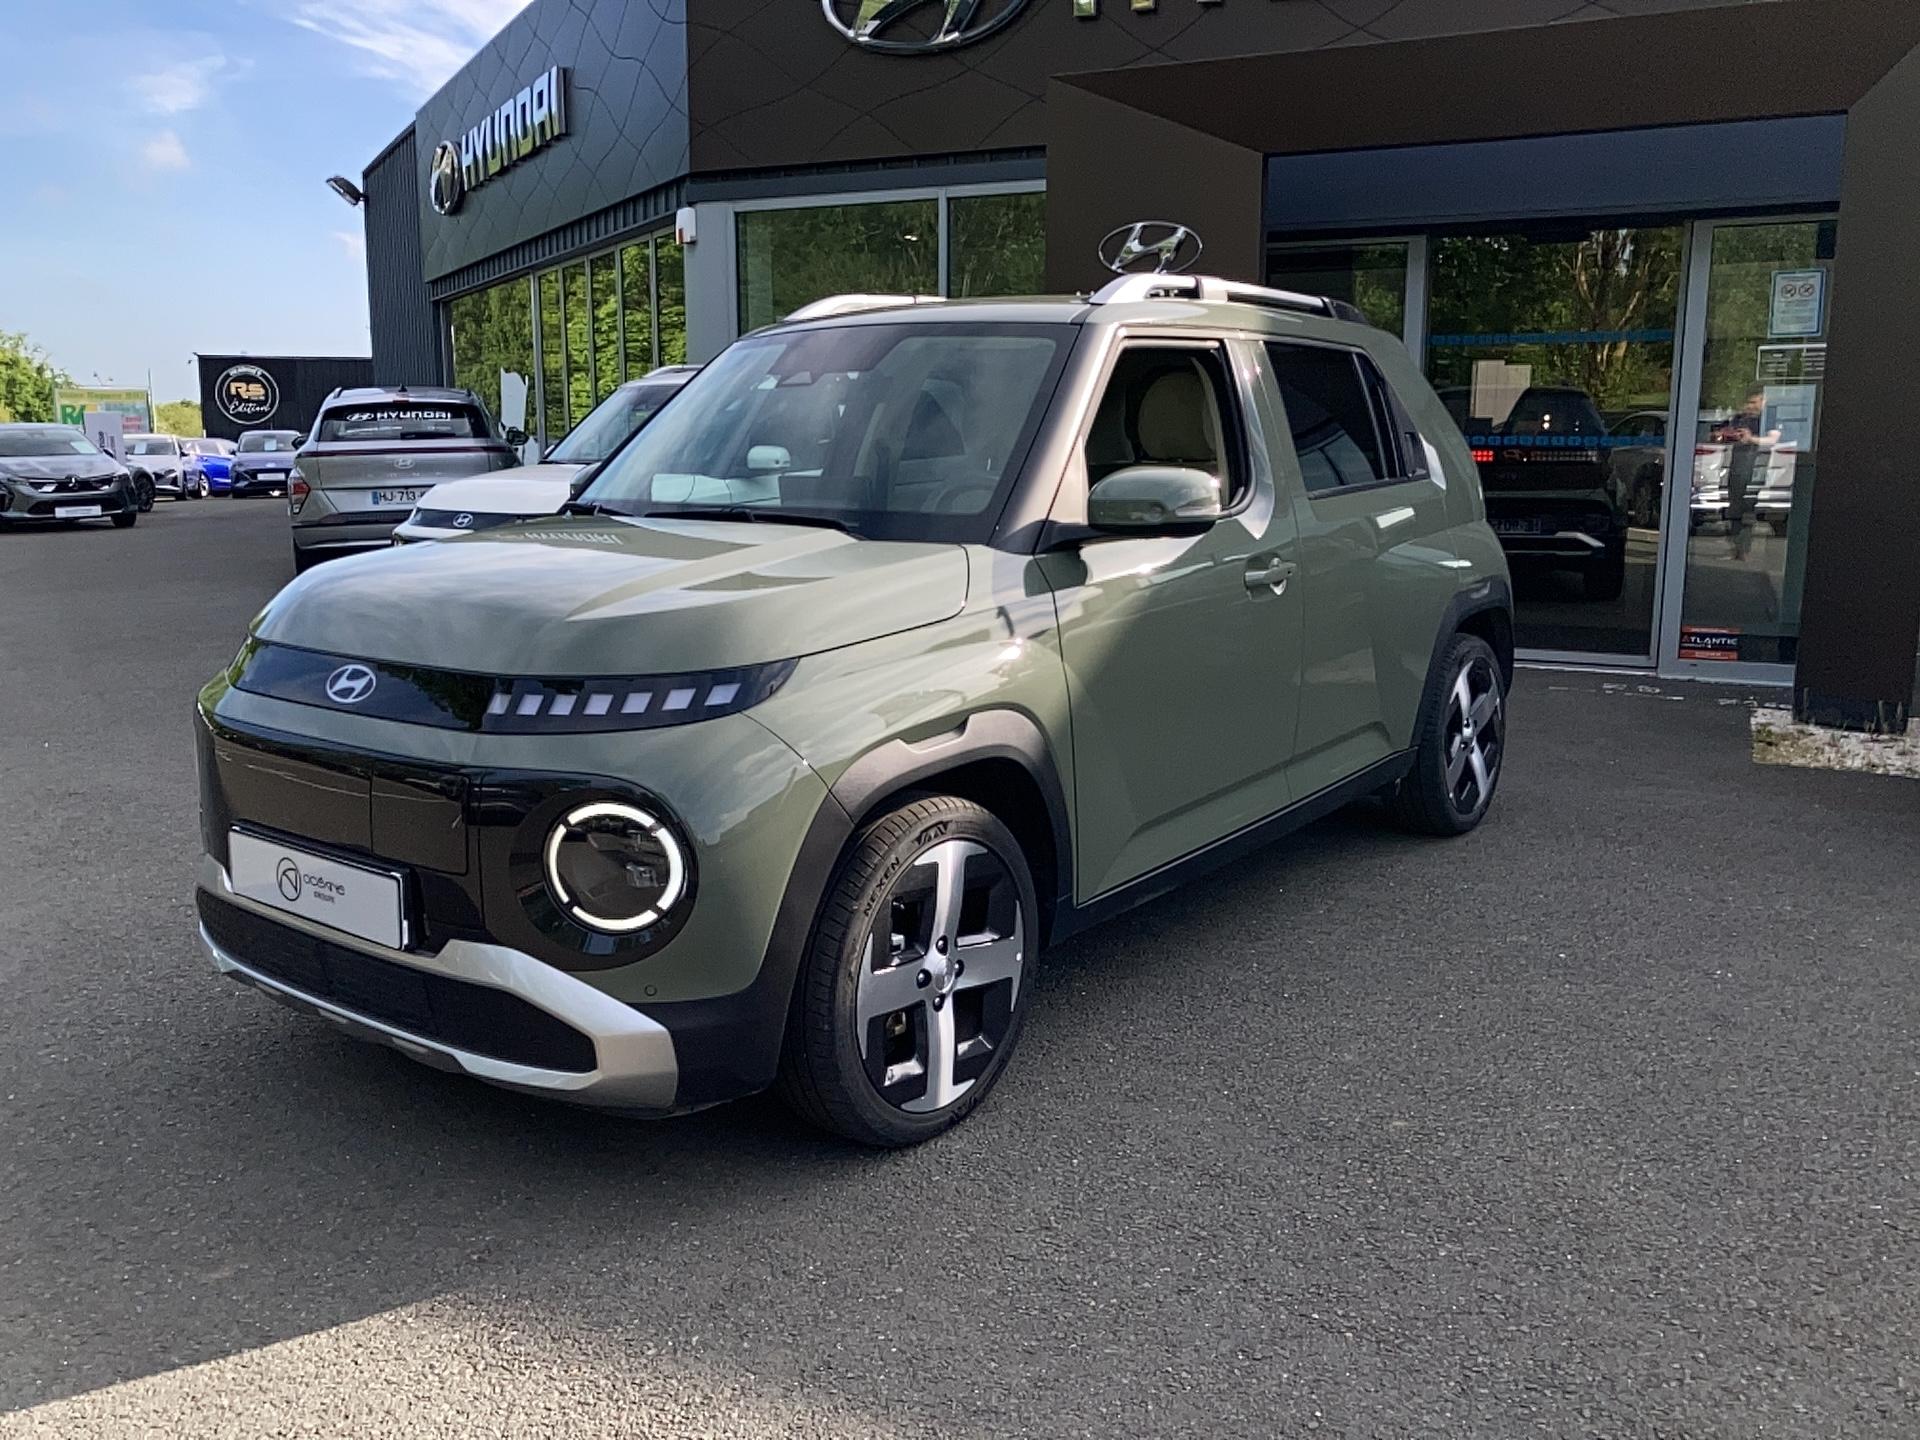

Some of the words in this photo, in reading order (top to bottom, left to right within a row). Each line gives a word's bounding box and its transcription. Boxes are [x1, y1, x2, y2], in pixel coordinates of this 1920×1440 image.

[461, 65, 566, 191] HYUNDAI
[230, 382, 265, 399] RS
[376, 411, 452, 421] HYUNDAI
[1681, 634, 1739, 646] ATLANTIC
[863, 856, 900, 917] NEXEN
